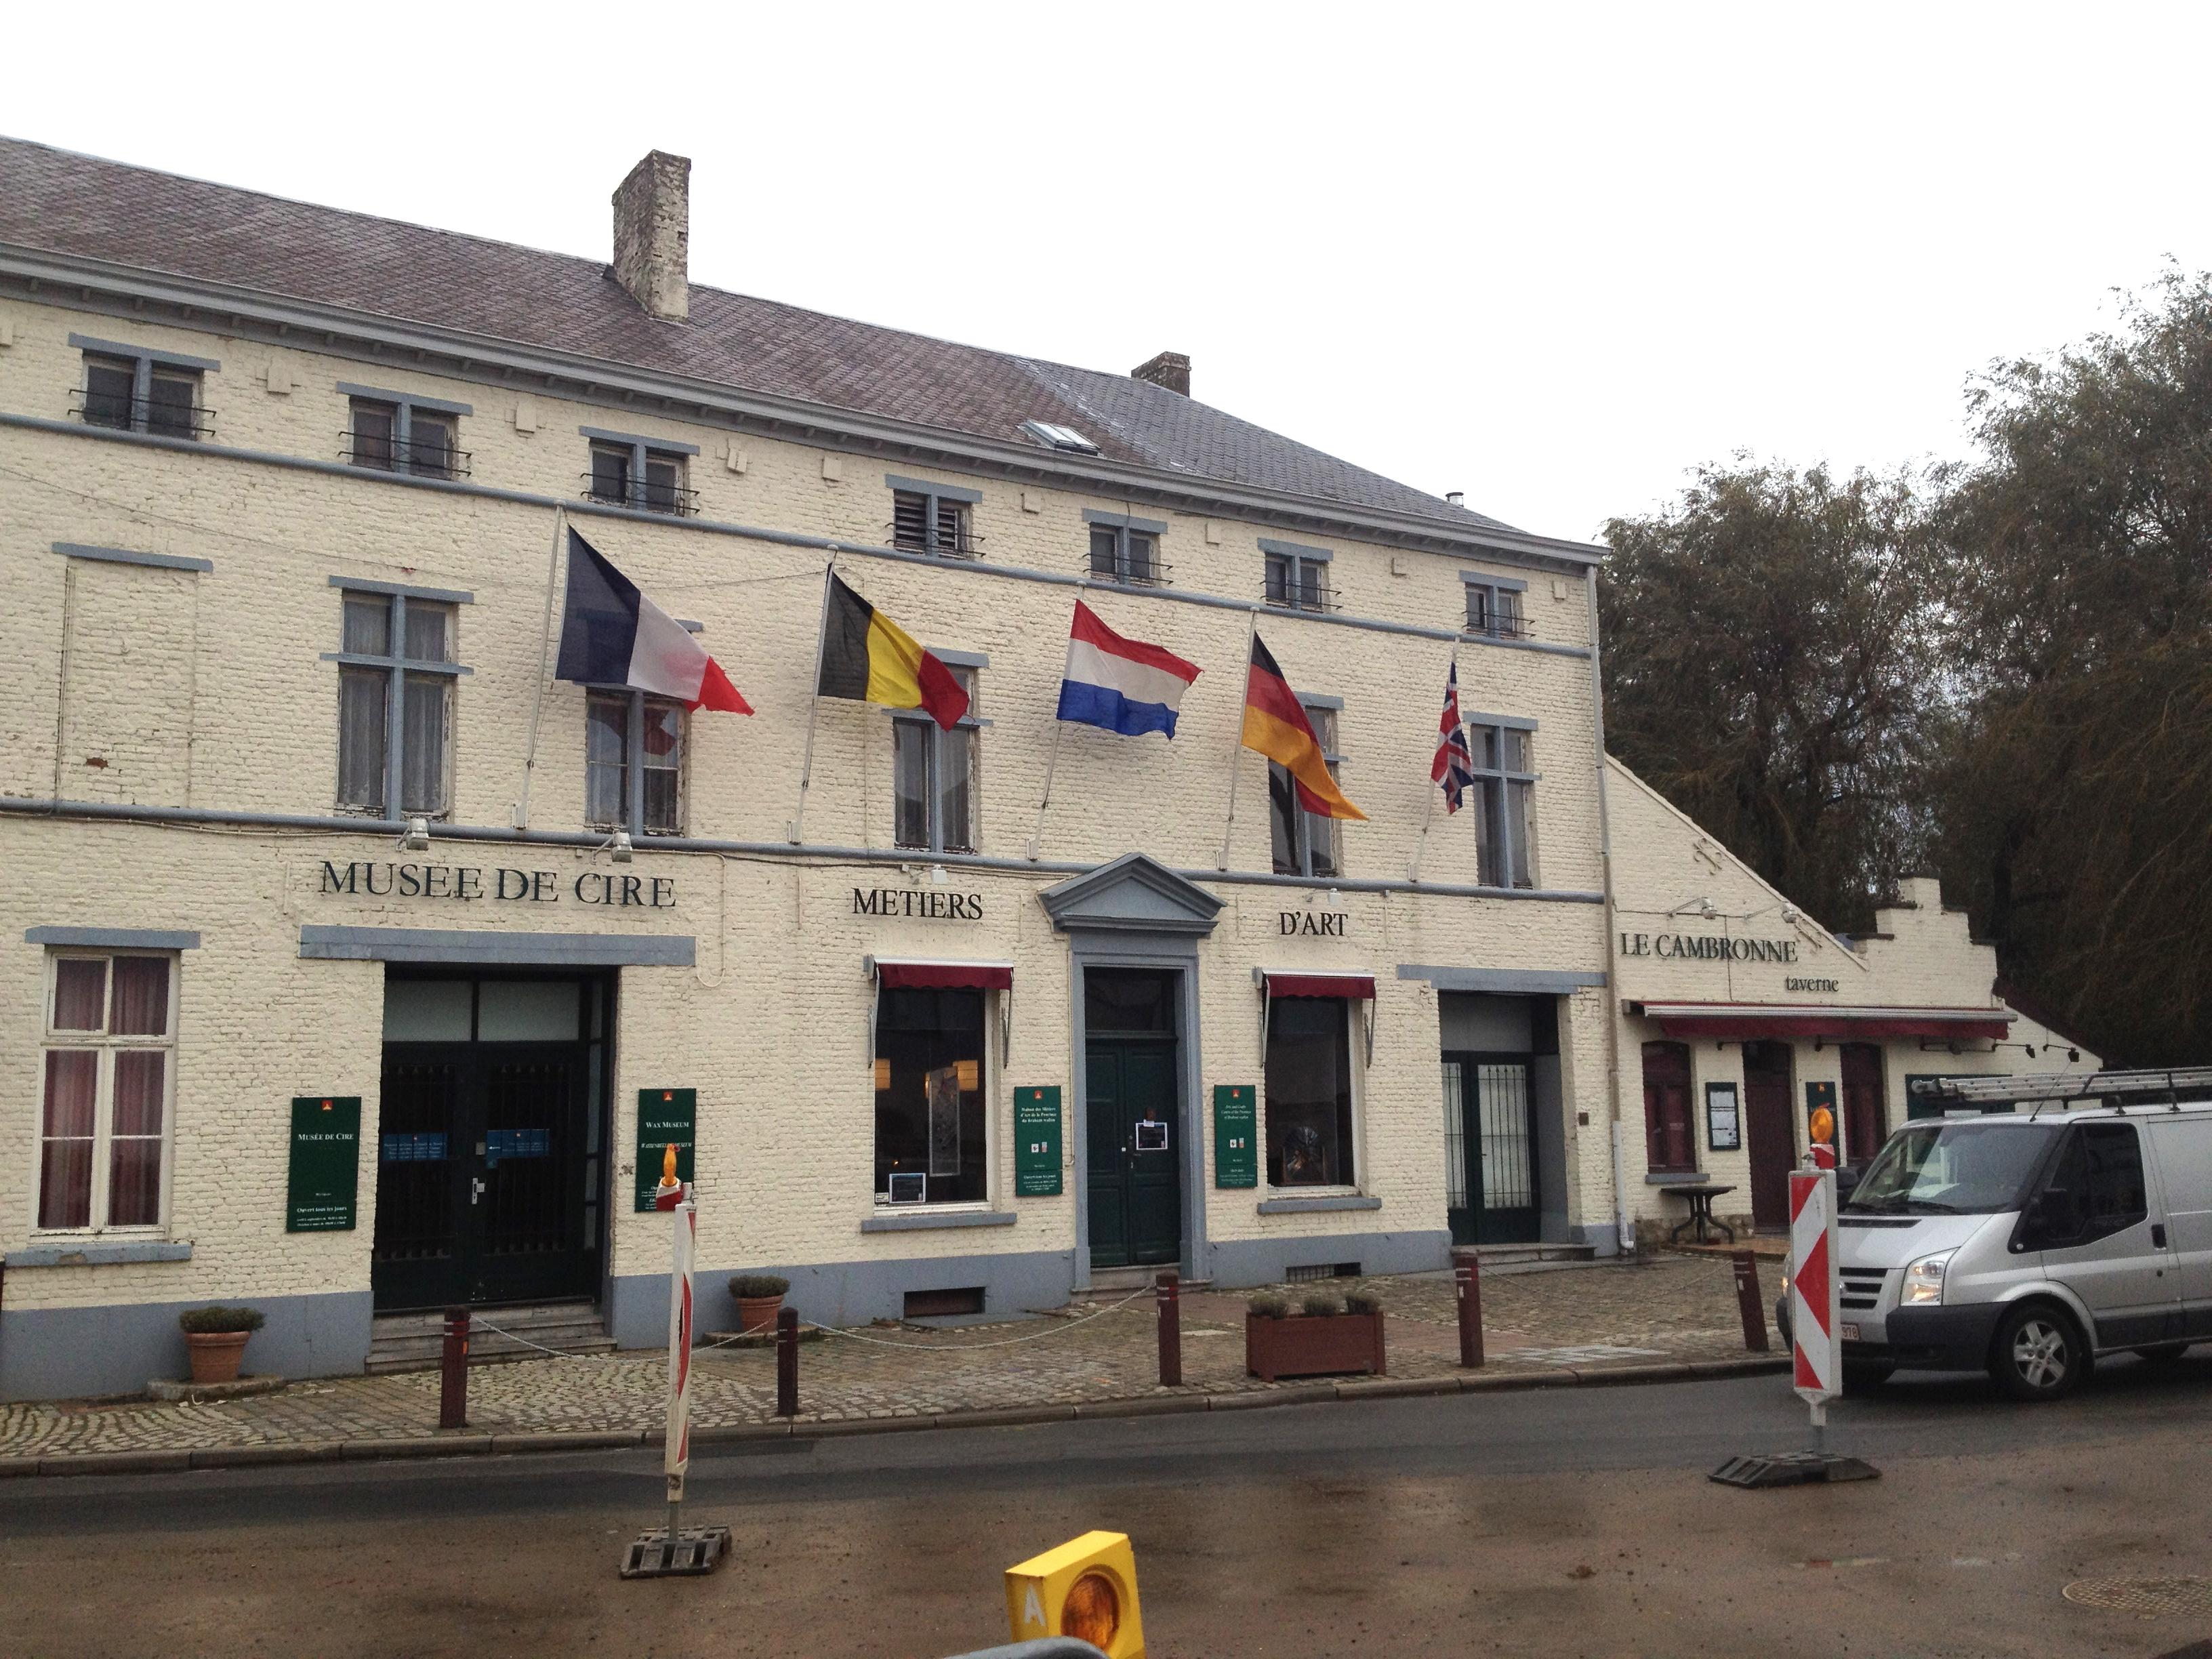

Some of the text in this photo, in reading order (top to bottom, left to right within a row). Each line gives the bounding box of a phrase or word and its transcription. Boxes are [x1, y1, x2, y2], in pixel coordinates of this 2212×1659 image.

[318, 861, 676, 907] MUSEE DE CIRE
[851, 887, 983, 920] METIERS
[1279, 911, 1349, 937] D'ART
[1621, 933, 1799, 962] LE CAMBRONNE
[1784, 976, 1839, 992] taverne
[1023, 1583, 1046, 1627] A
